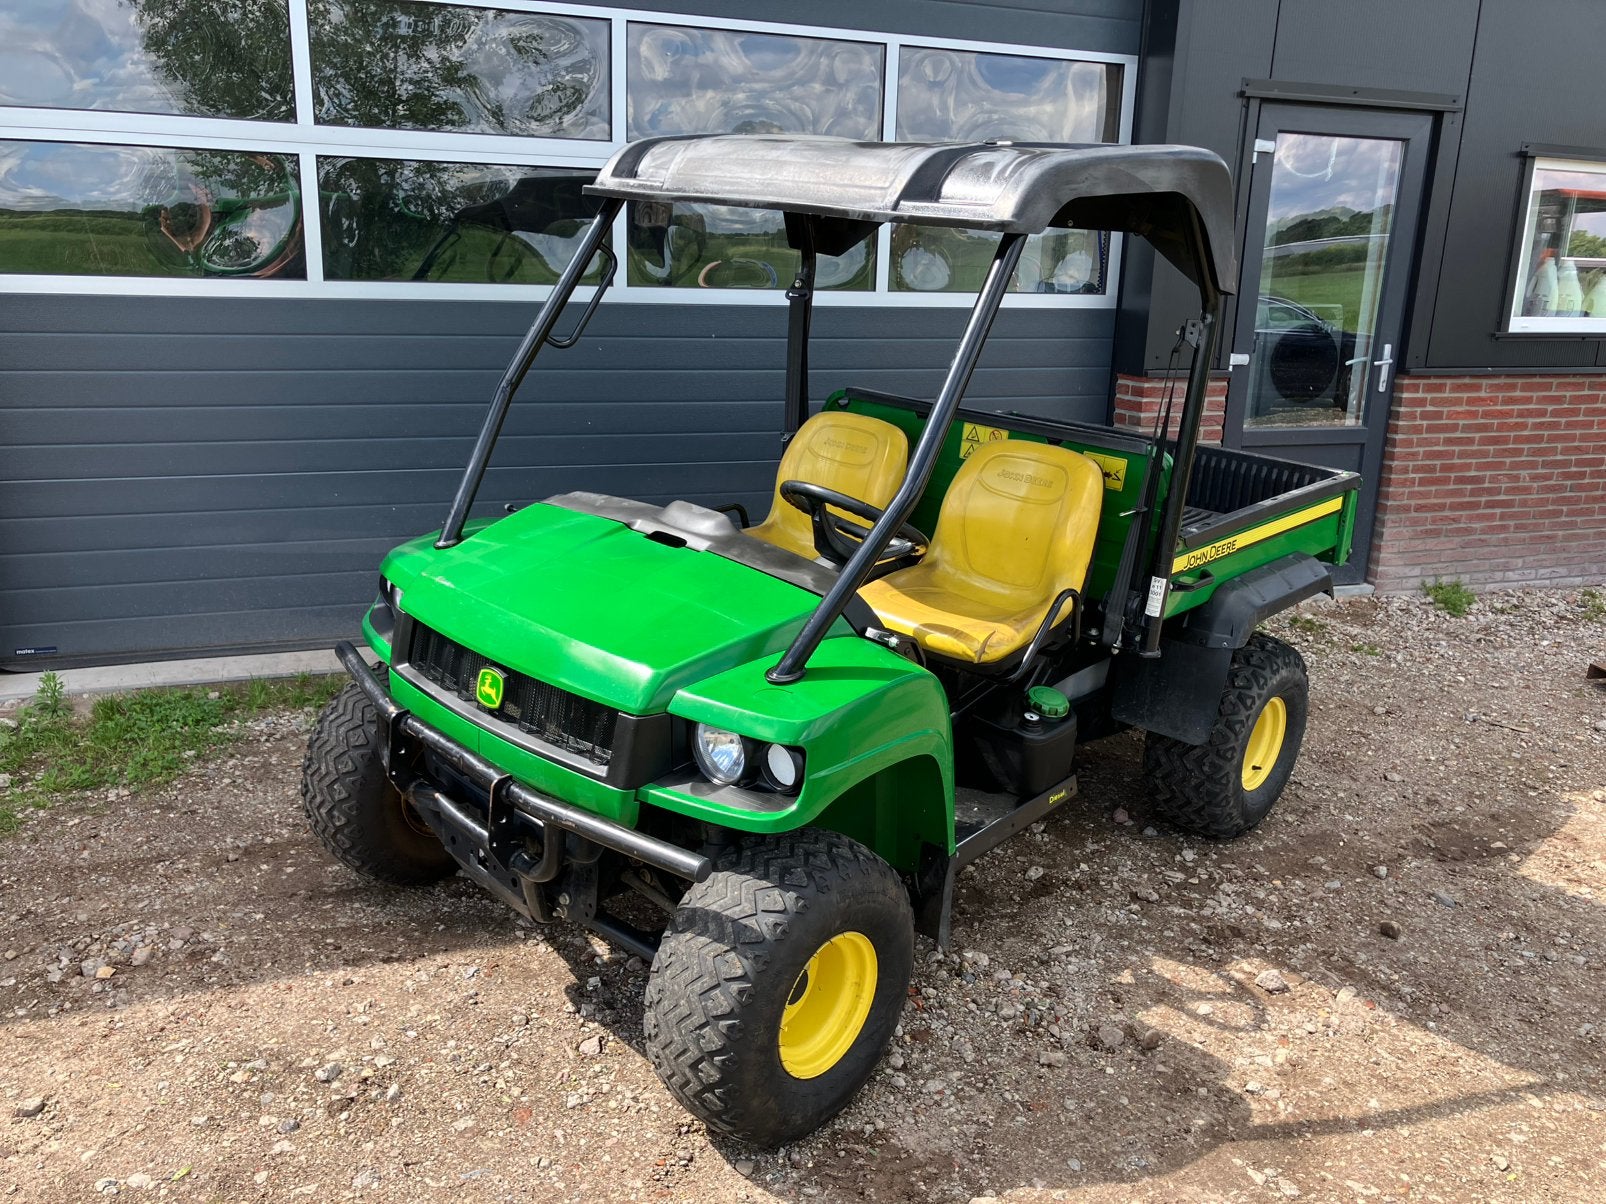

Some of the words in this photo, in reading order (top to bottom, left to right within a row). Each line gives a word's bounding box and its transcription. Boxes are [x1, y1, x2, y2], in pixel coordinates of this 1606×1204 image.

[997, 469, 1023, 482] JOHN
[1024, 474, 1053, 488] DEERE
[1184, 550, 1209, 569] JOHN
[1209, 540, 1238, 560] DEERE
[1049, 789, 1065, 804] Diesel
